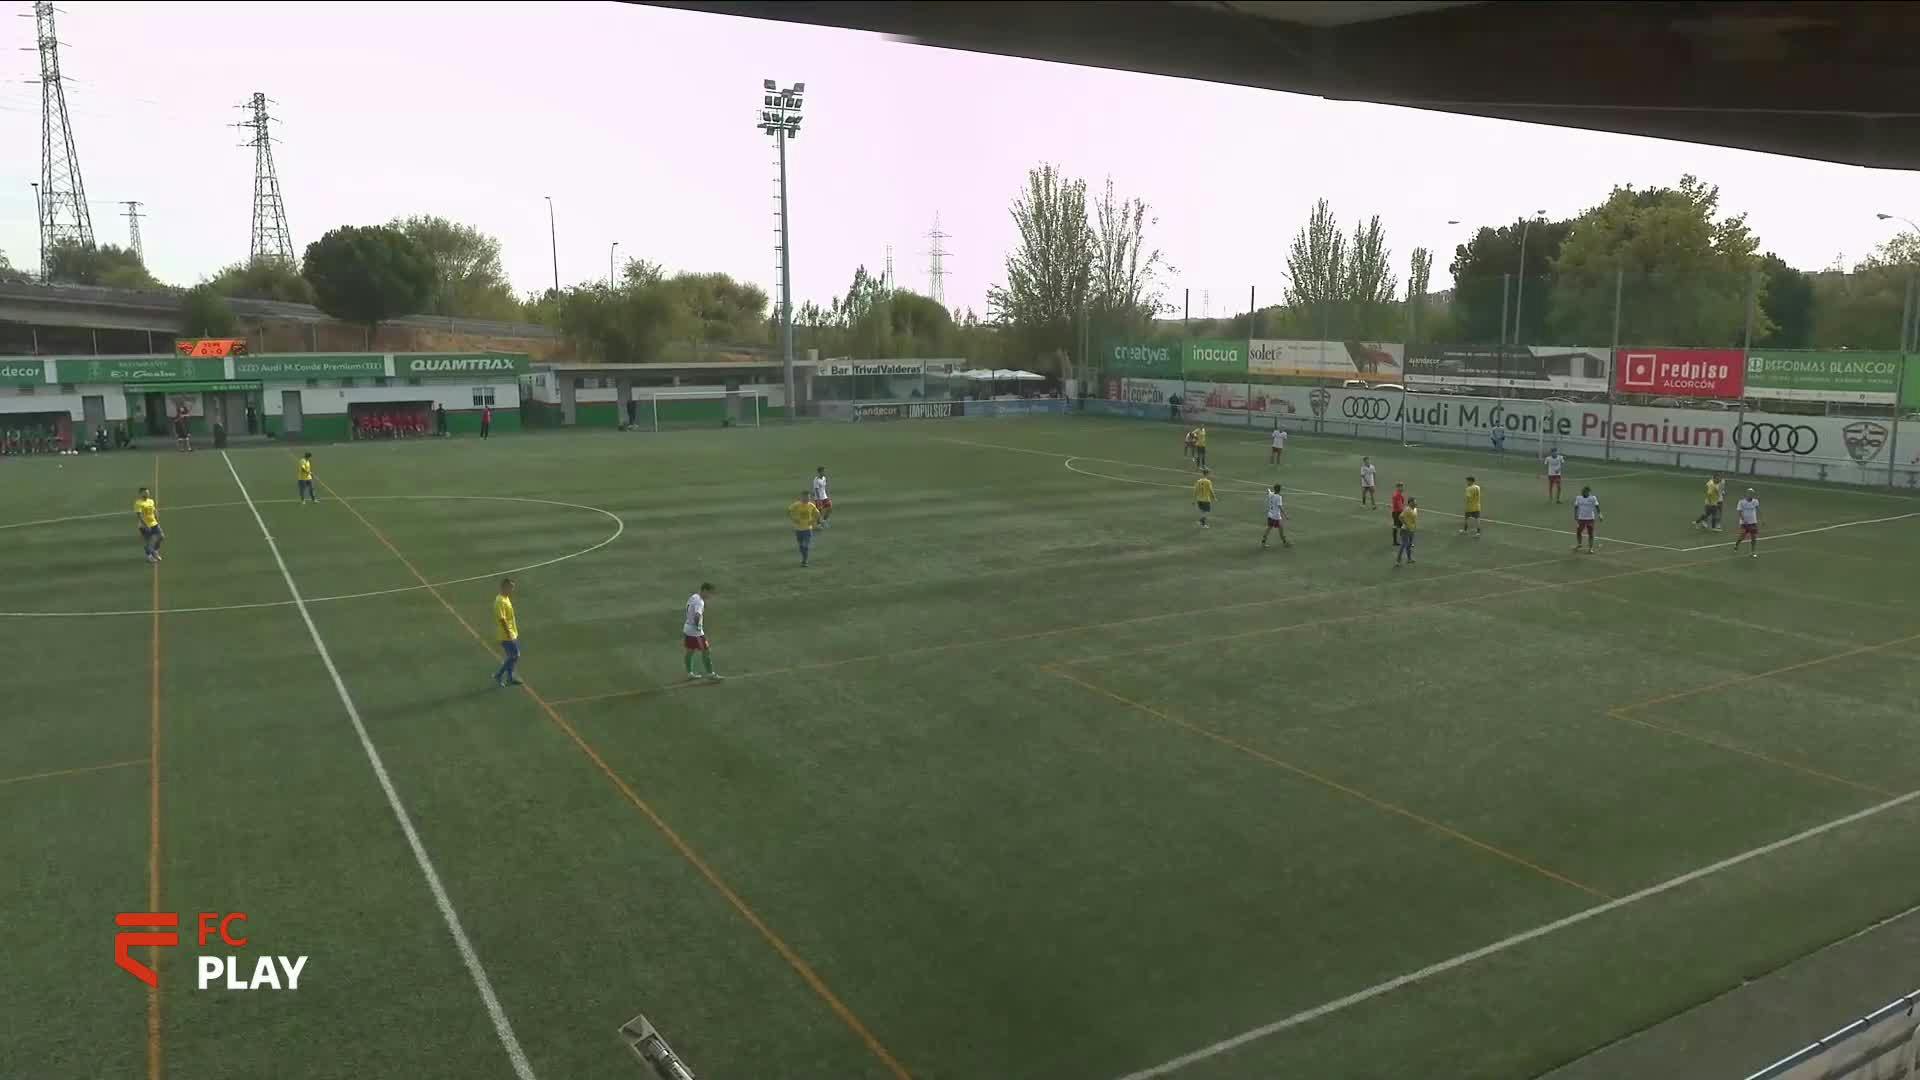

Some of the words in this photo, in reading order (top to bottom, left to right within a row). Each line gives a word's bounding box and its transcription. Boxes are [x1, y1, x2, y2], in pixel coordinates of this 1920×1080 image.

[1193, 345, 1238, 361] inacua
[410, 359, 514, 371] QUAMTRAX
[831, 365, 849, 375] Bar
[1661, 361, 1729, 379] redpiso
[0, 366, 40, 377] decor
[1663, 378, 1716, 390] ALCORCÓN
[1394, 403, 1450, 426] Audi
[1581, 412, 1725, 449] Premium
